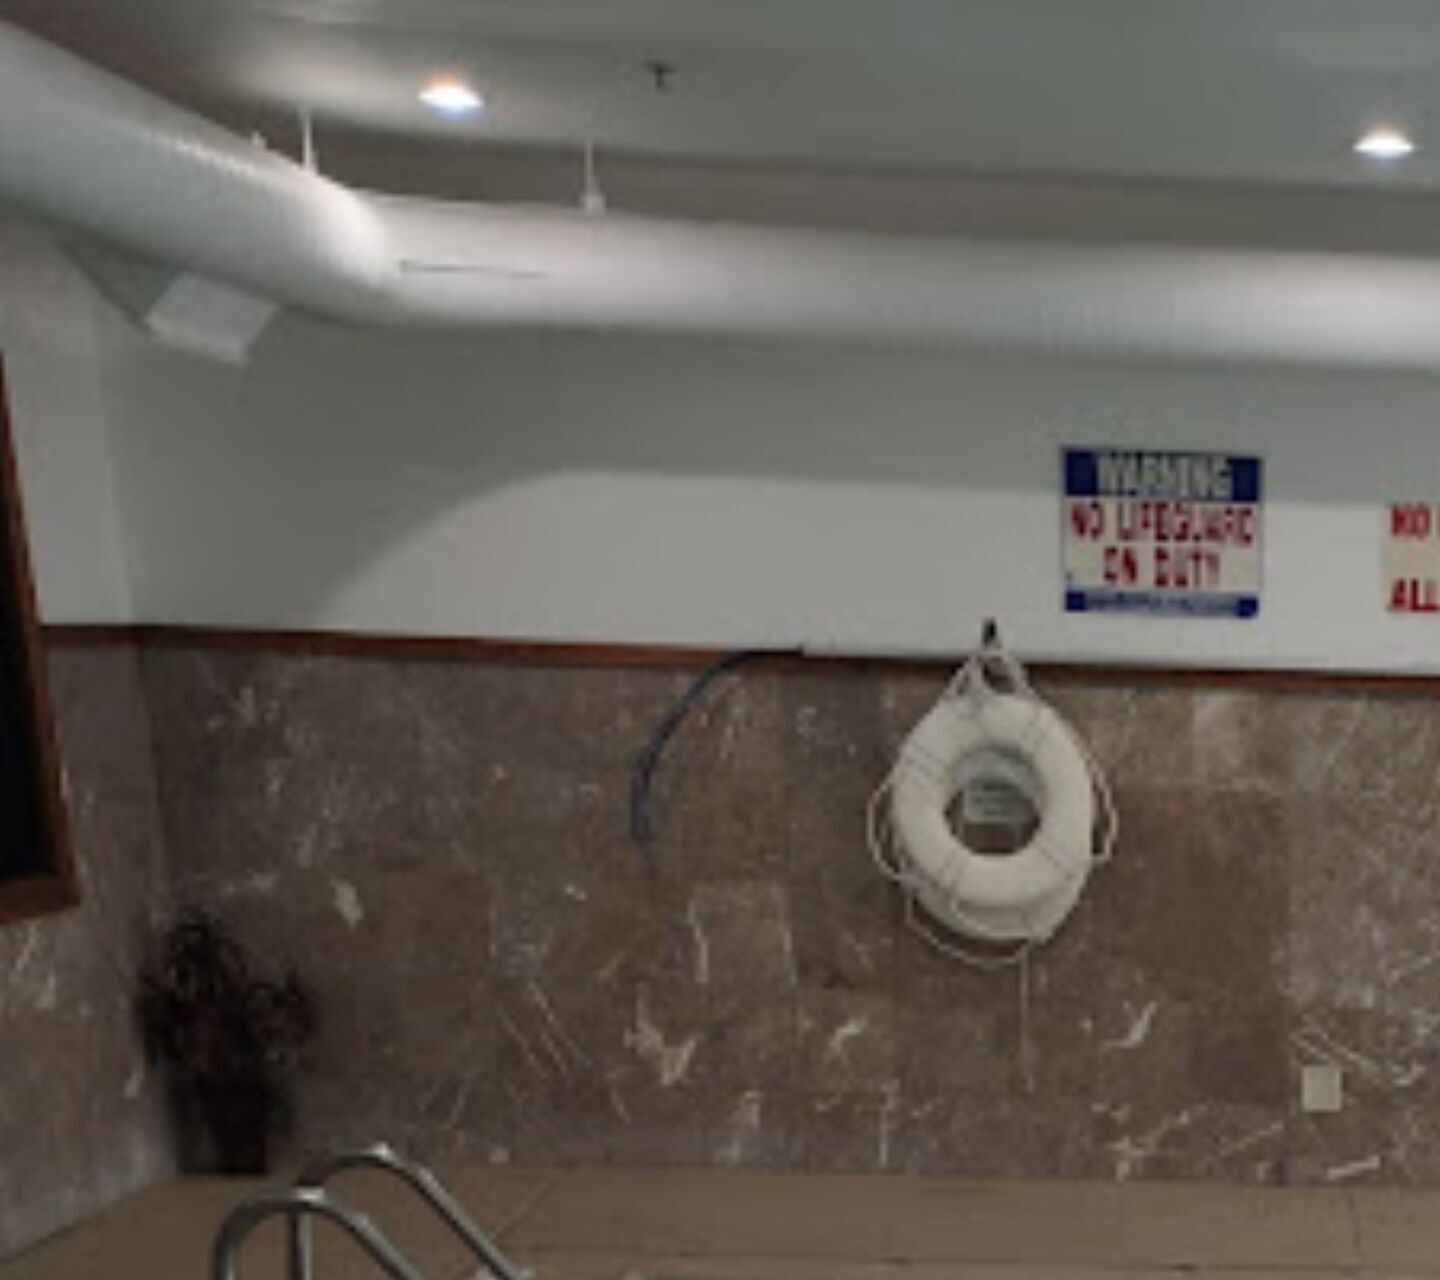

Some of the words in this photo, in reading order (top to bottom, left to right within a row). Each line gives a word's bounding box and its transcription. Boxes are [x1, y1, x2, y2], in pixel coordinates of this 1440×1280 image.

[1097, 453, 1230, 501] WARNING
[1070, 503, 1104, 541] NO
[1117, 502, 1255, 547] LIFEGUARD
[1390, 504, 1431, 540] NO
[1103, 547, 1138, 583] ON
[1154, 548, 1220, 588] DUTY
